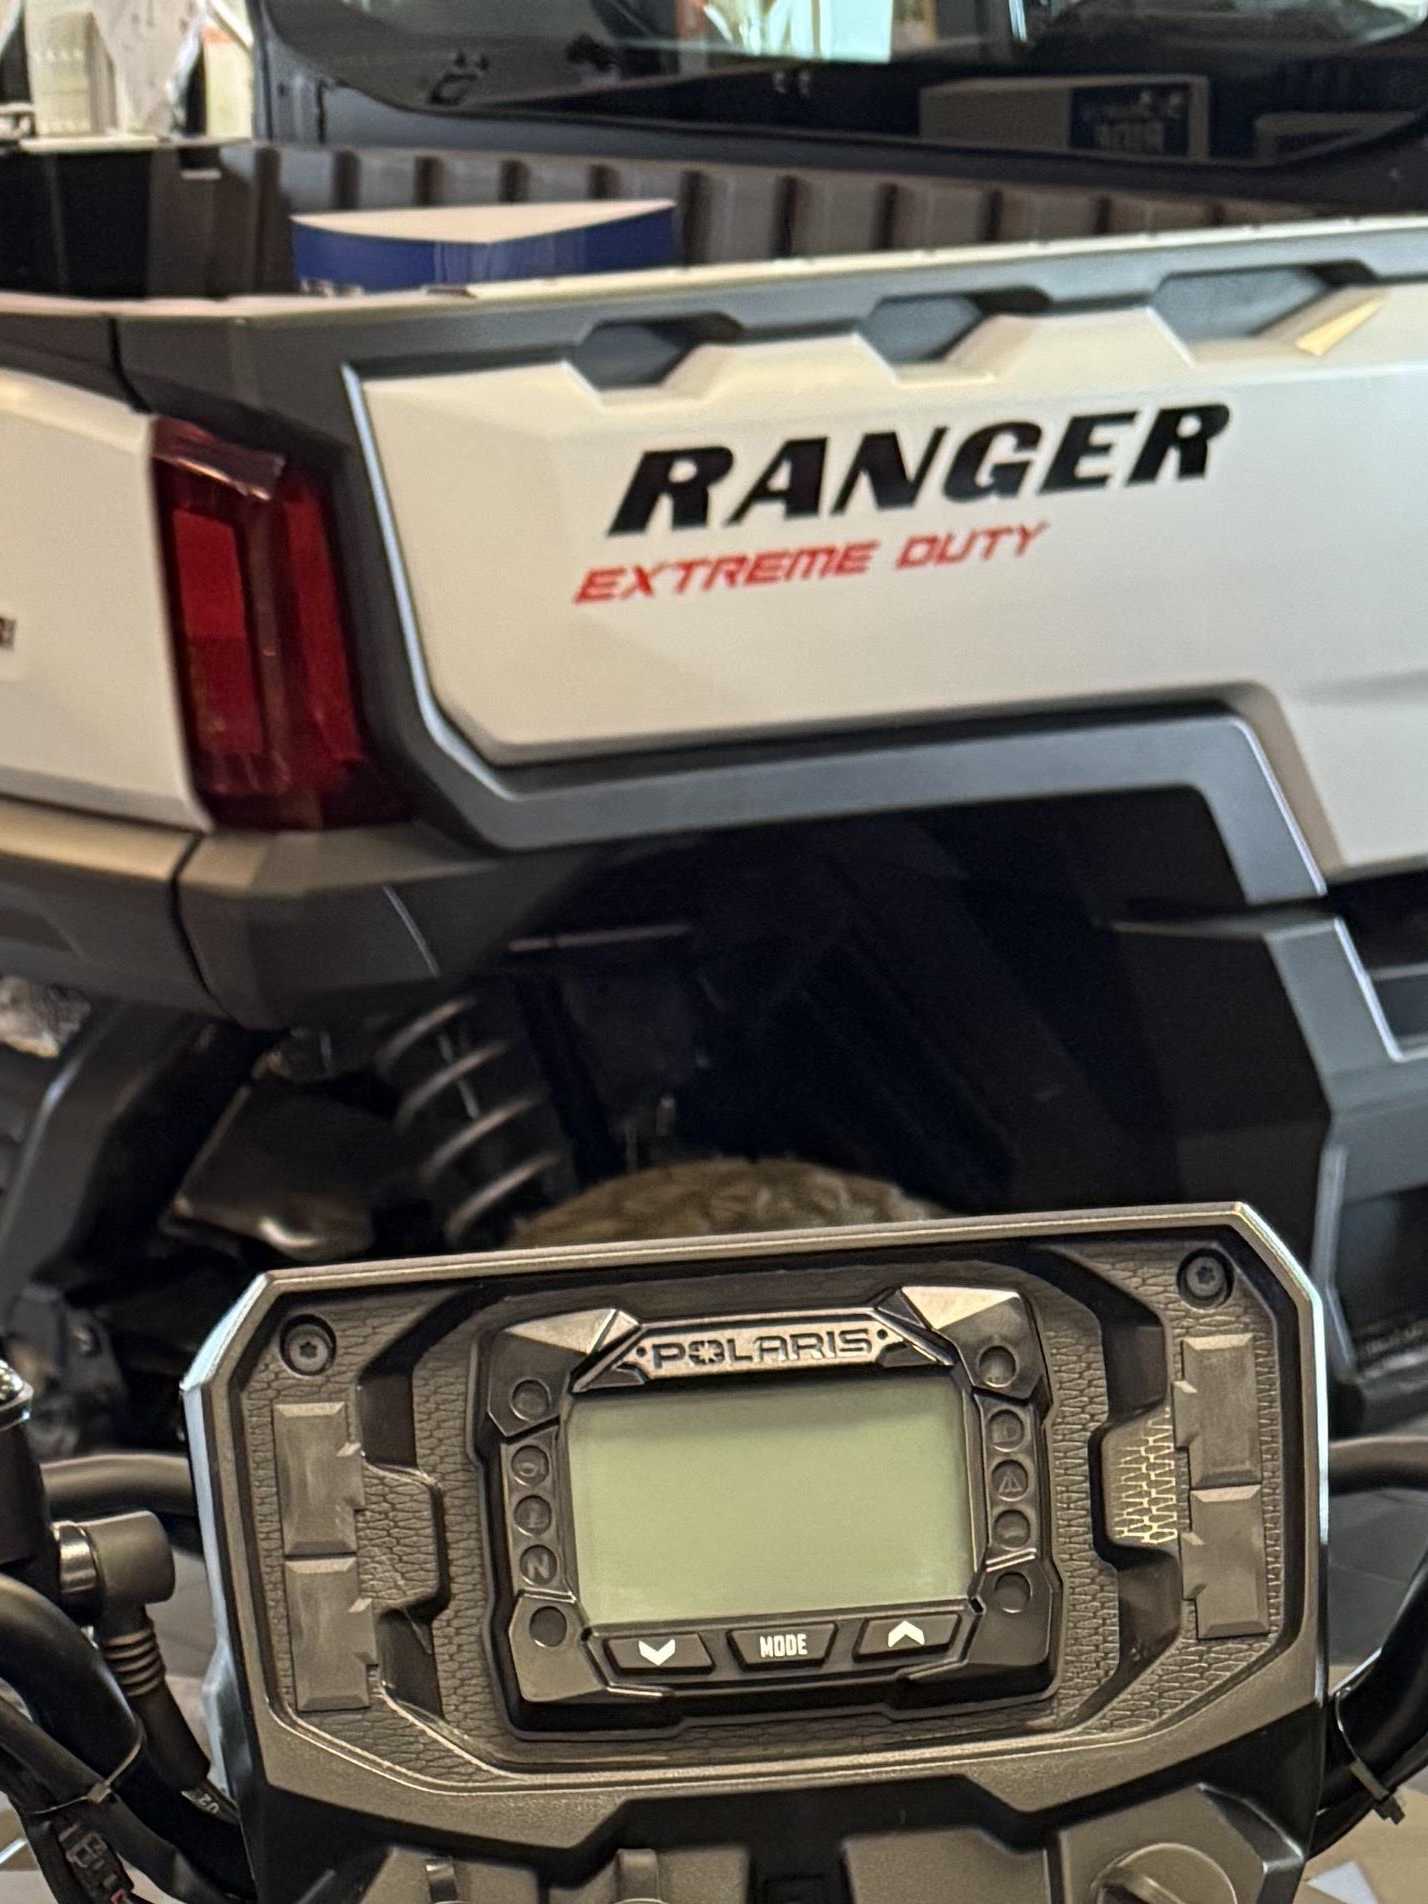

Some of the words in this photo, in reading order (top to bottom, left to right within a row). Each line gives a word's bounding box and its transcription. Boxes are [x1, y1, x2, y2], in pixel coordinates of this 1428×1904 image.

[607, 404, 1230, 536] RANGER
[572, 540, 879, 605] EXTREME
[896, 521, 1049, 571] DUTY
[650, 1329, 871, 1369] POLARIS
[759, 1633, 807, 1658] MODE
